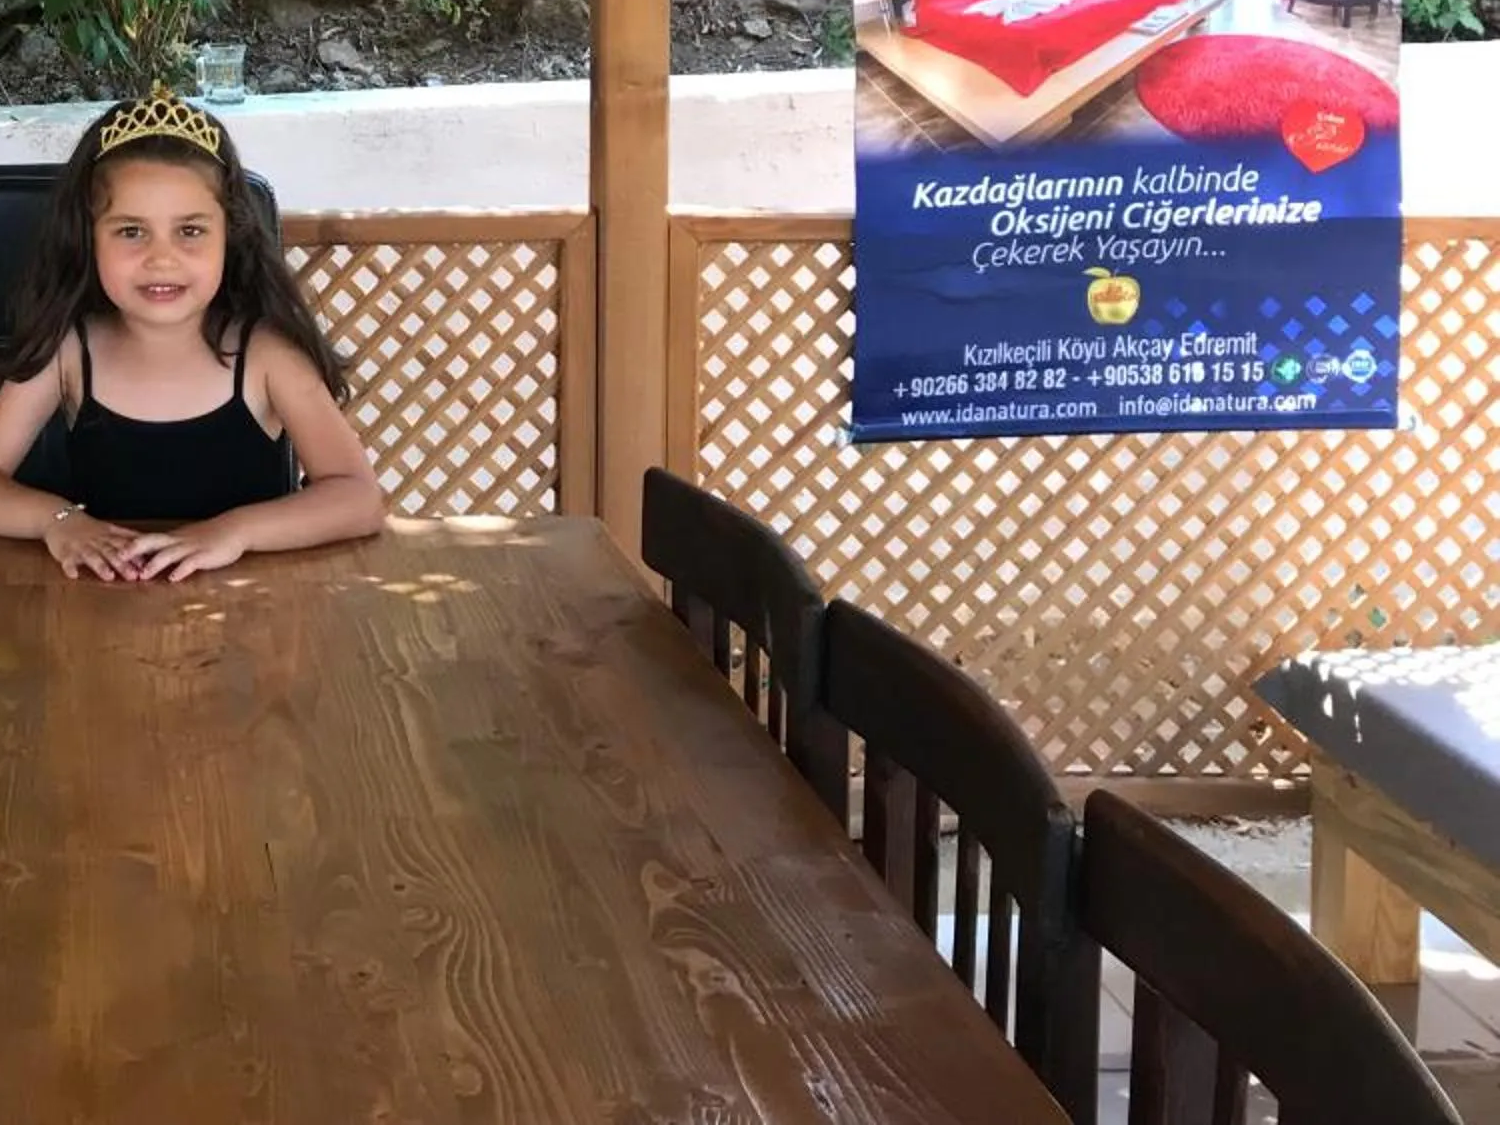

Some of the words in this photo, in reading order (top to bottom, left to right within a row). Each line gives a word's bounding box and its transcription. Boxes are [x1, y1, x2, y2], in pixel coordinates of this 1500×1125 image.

[912, 172, 1124, 209] Kazdağlarının
[1132, 162, 1259, 195] kalbinde
[990, 203, 1116, 238] Oksijeni
[1122, 195, 1322, 233] Ciğerlerinize
[972, 235, 1085, 274] Çekerek
[1057, 336, 1106, 364] Köyü
[1113, 335, 1174, 362] Akçay
[1180, 331, 1258, 357] Edremit
[893, 373, 969, 398] +90266
[973, 370, 1008, 392] 384
[1014, 369, 1037, 390] 82
[1043, 367, 1067, 388] 82
[1087, 364, 1163, 386] +90538
[1212, 361, 1235, 383] 15
[1241, 360, 1265, 381] 15
[901, 401, 1098, 425] www.idanatura.com
[1119, 393, 1317, 416] info@idanatura.com
